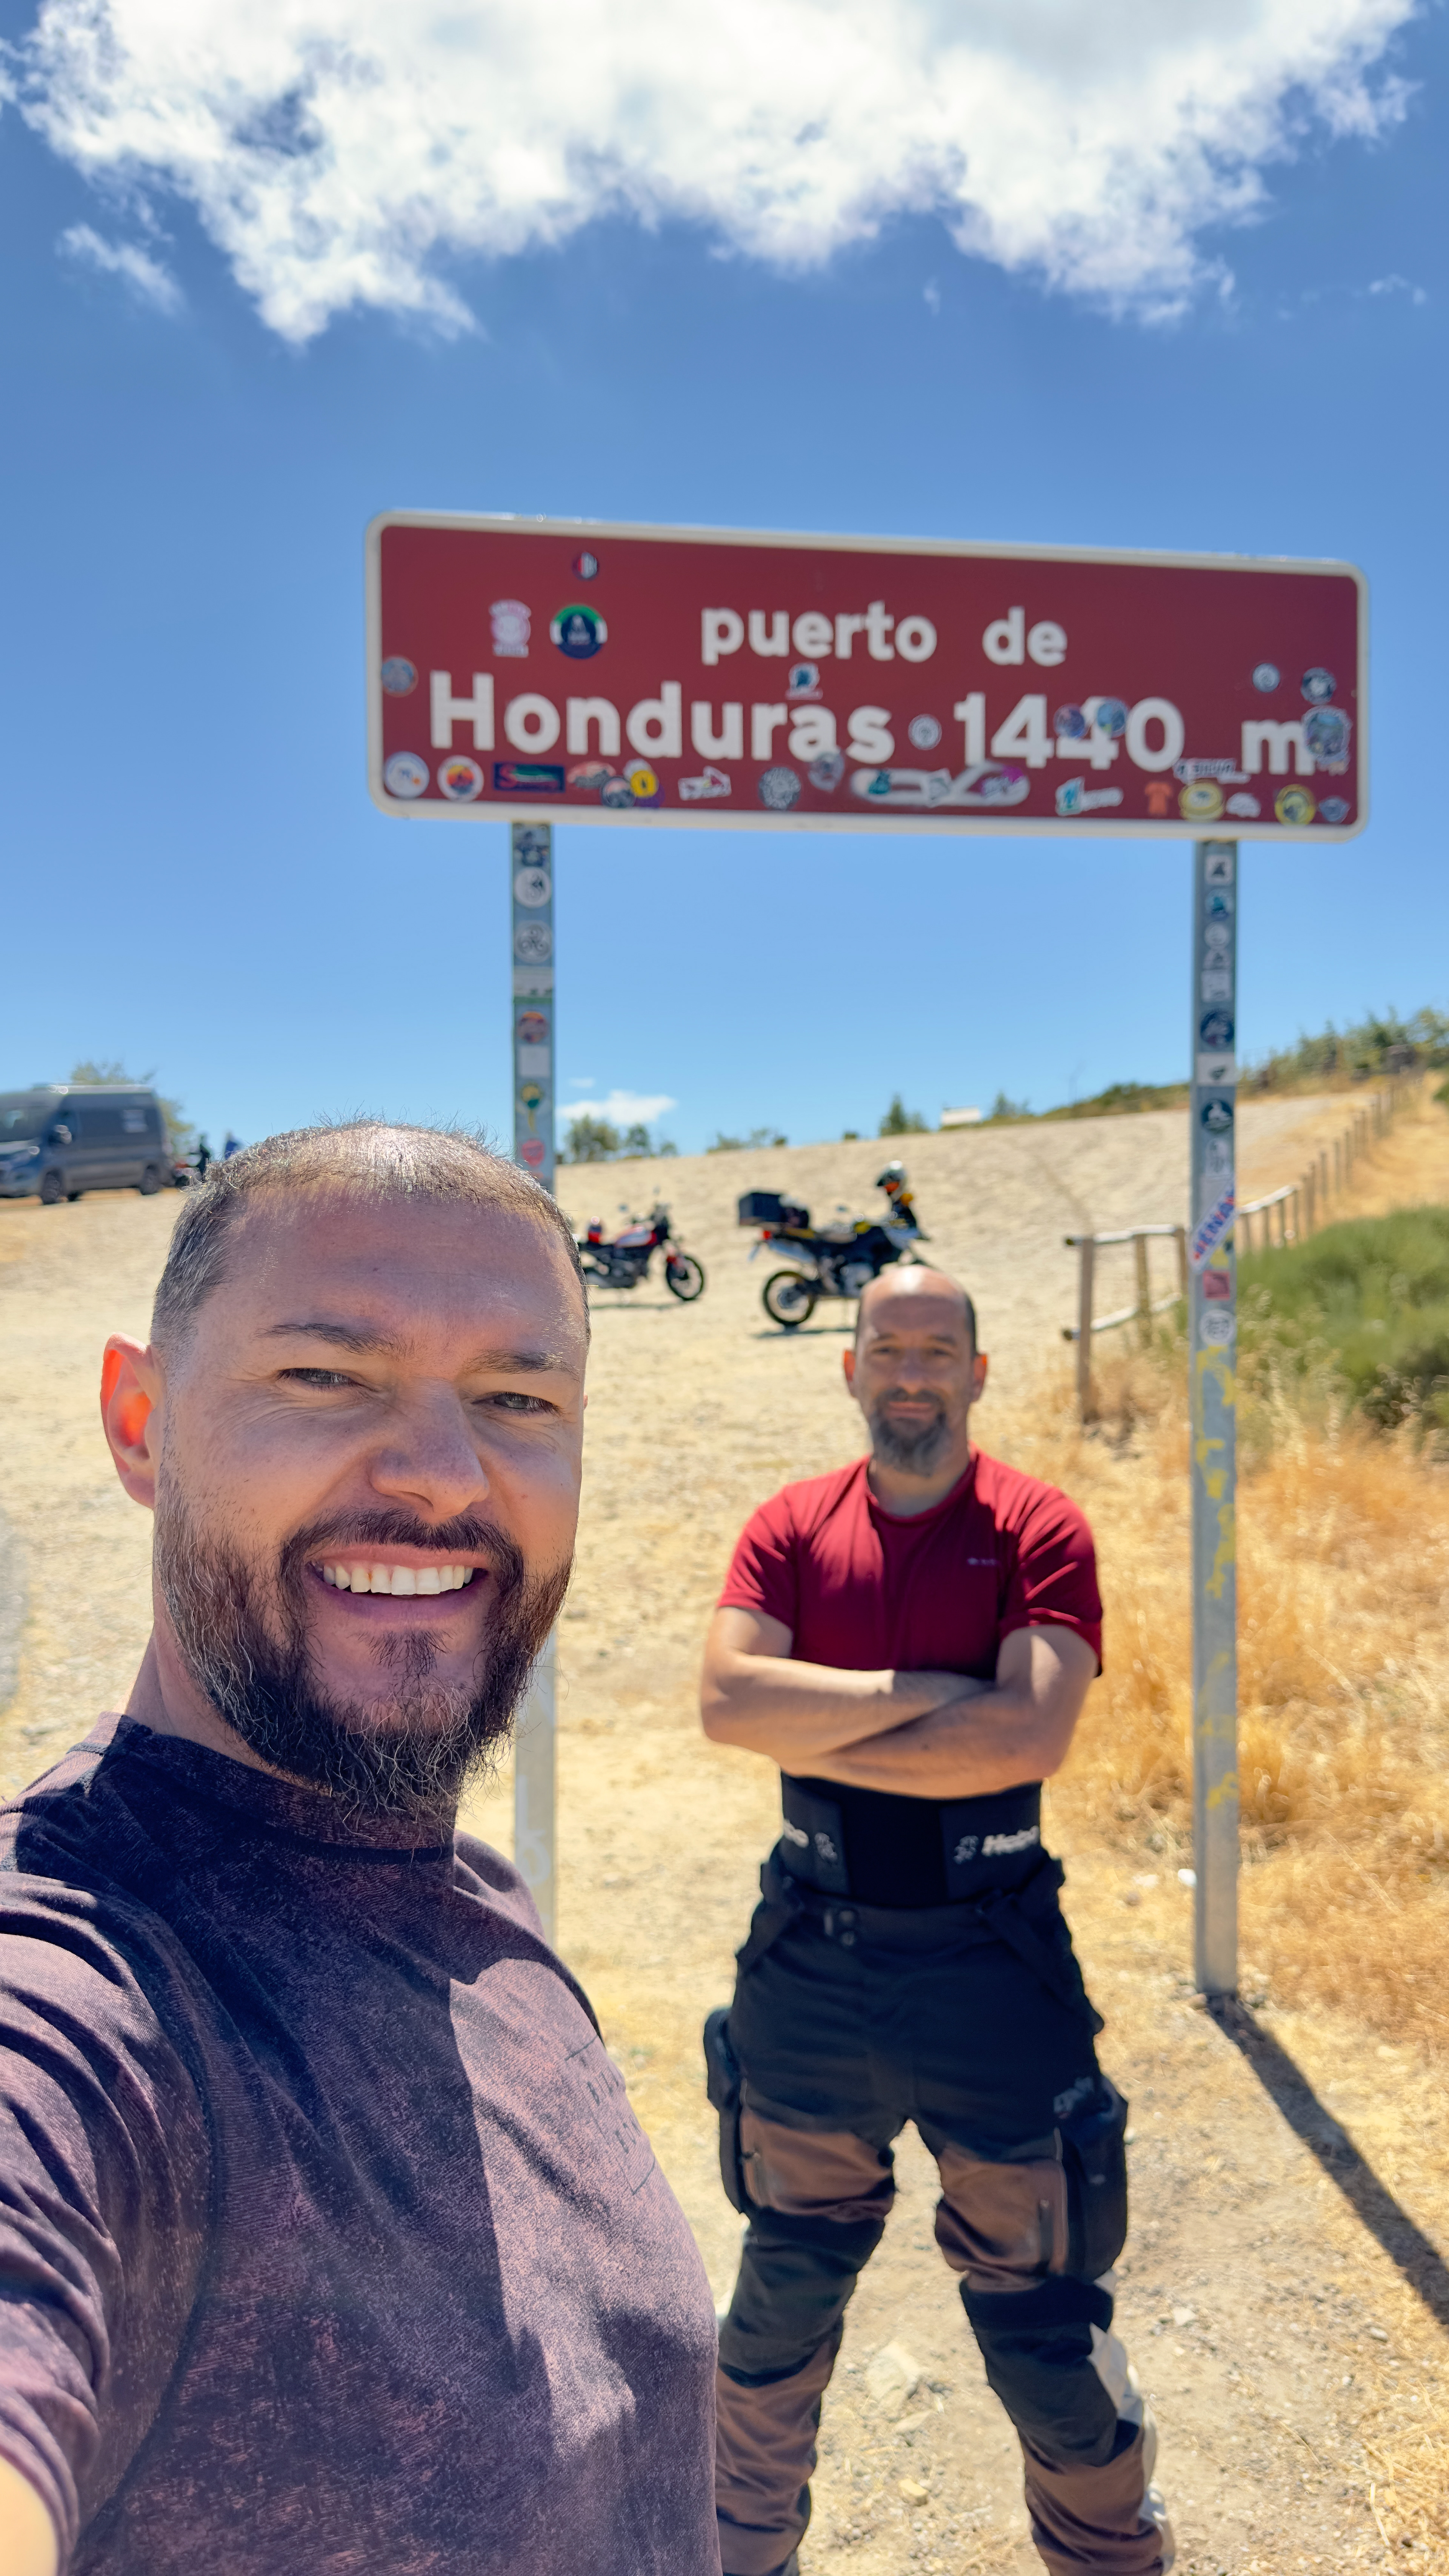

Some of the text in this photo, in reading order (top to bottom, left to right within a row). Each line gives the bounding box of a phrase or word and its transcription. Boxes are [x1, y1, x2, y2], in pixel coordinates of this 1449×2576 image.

[701, 602, 1068, 666] puerto de
[430, 671, 1316, 776] Honduras 1440 m
